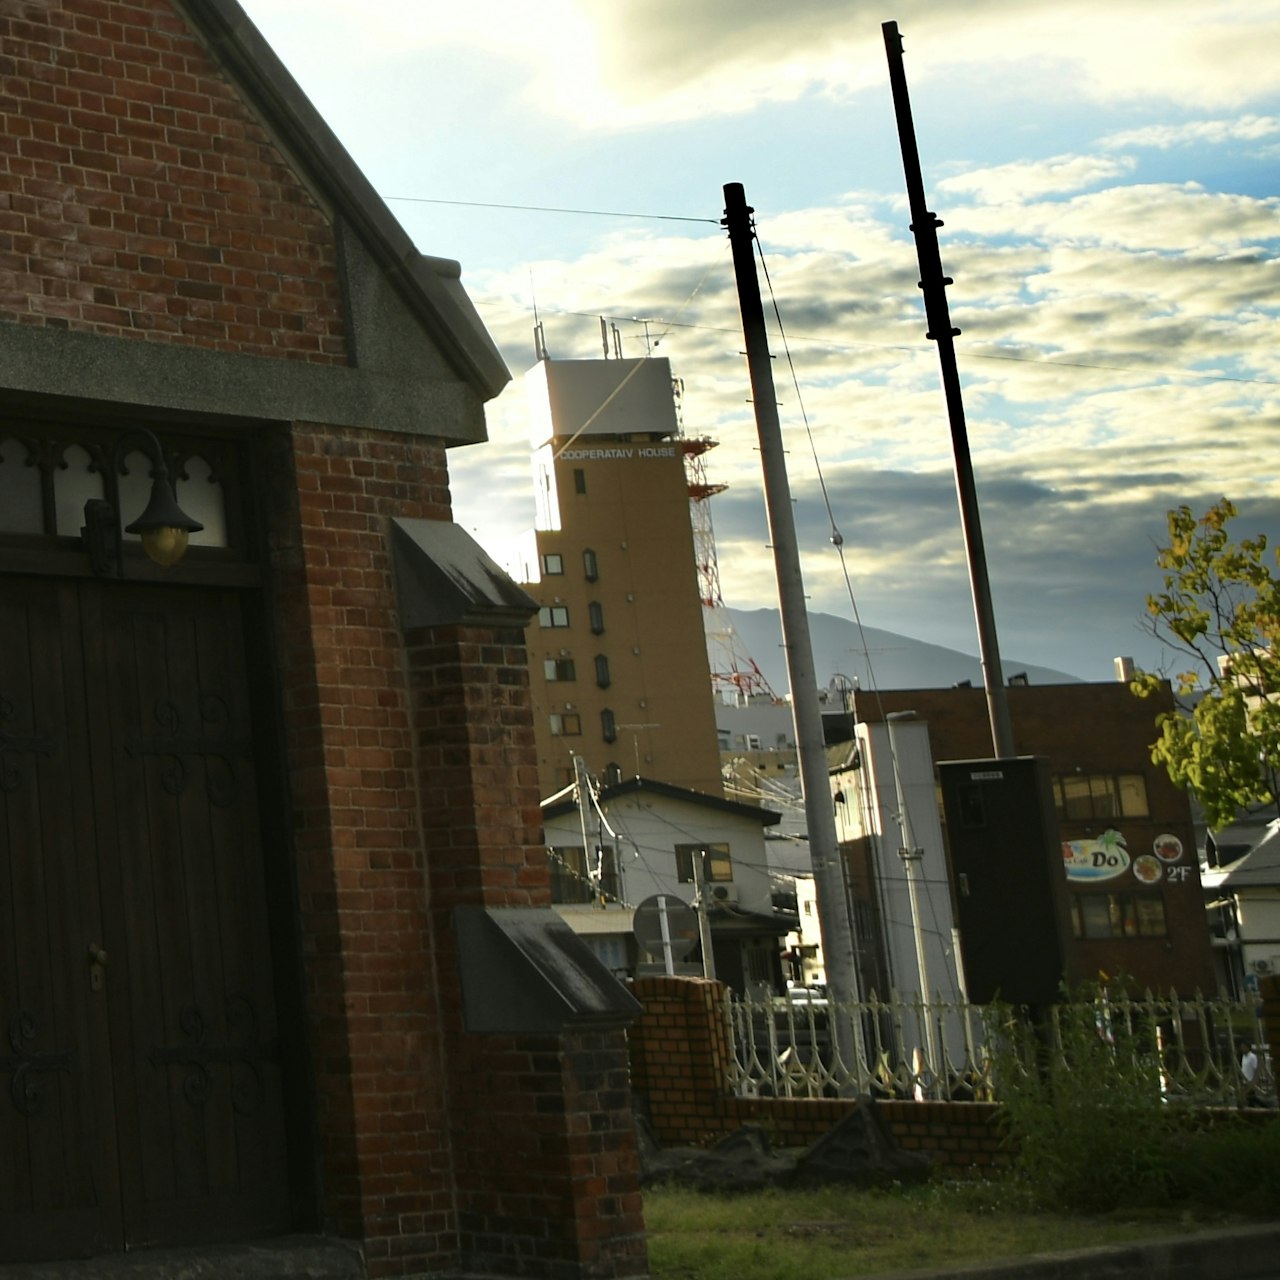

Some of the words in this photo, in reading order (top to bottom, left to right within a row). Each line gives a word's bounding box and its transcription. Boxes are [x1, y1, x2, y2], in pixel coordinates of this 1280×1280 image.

[560, 448, 633, 460] COOPERATAIV
[638, 447, 675, 458] HOUSE
[1091, 851, 1119, 867] Do
[1167, 866, 1191, 882] 2F
